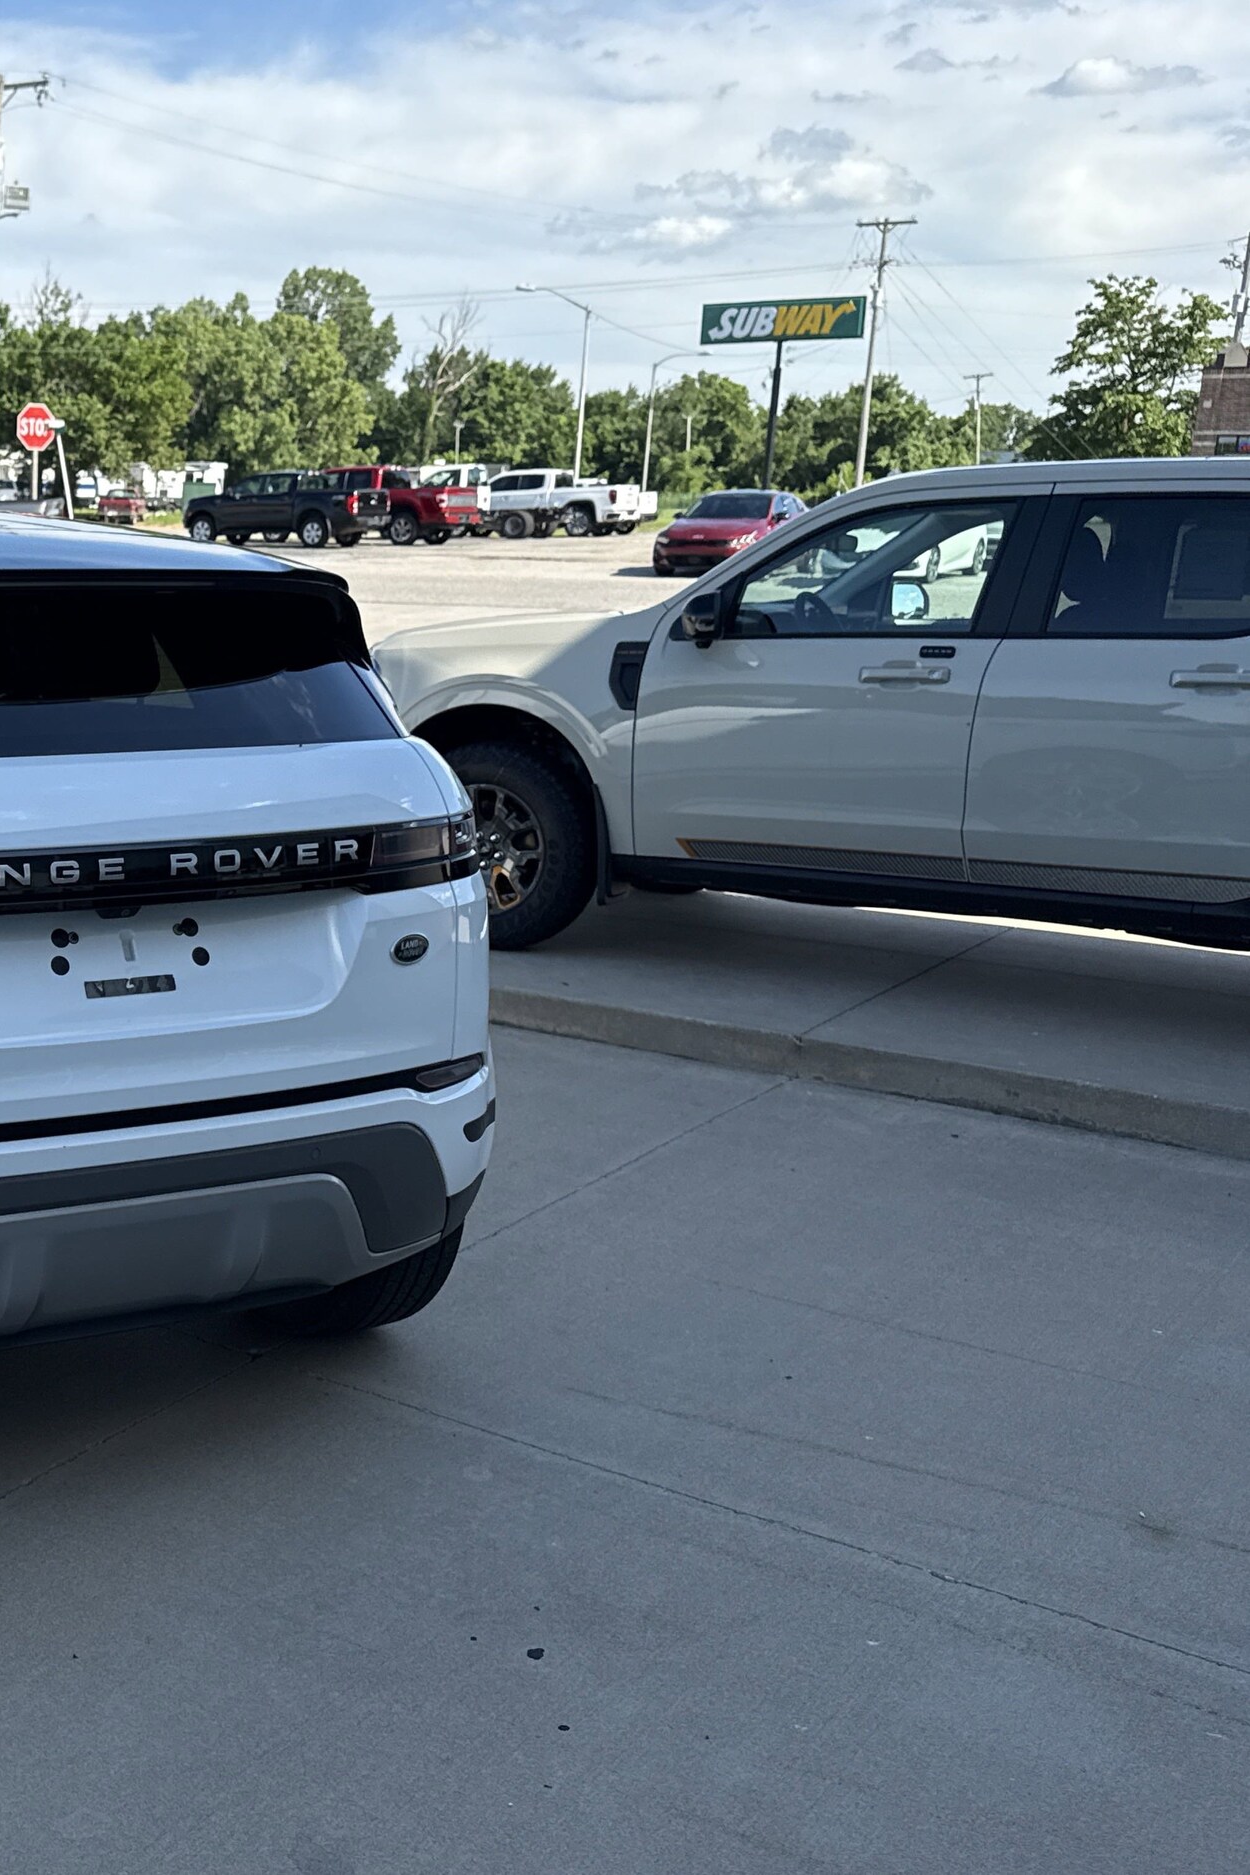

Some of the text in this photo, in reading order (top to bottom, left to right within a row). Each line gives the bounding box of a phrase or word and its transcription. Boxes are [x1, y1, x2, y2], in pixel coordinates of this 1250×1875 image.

[708, 300, 856, 341] SUBWAY
[169, 839, 359, 876] ROVER
[400, 940, 419, 950] LAND
